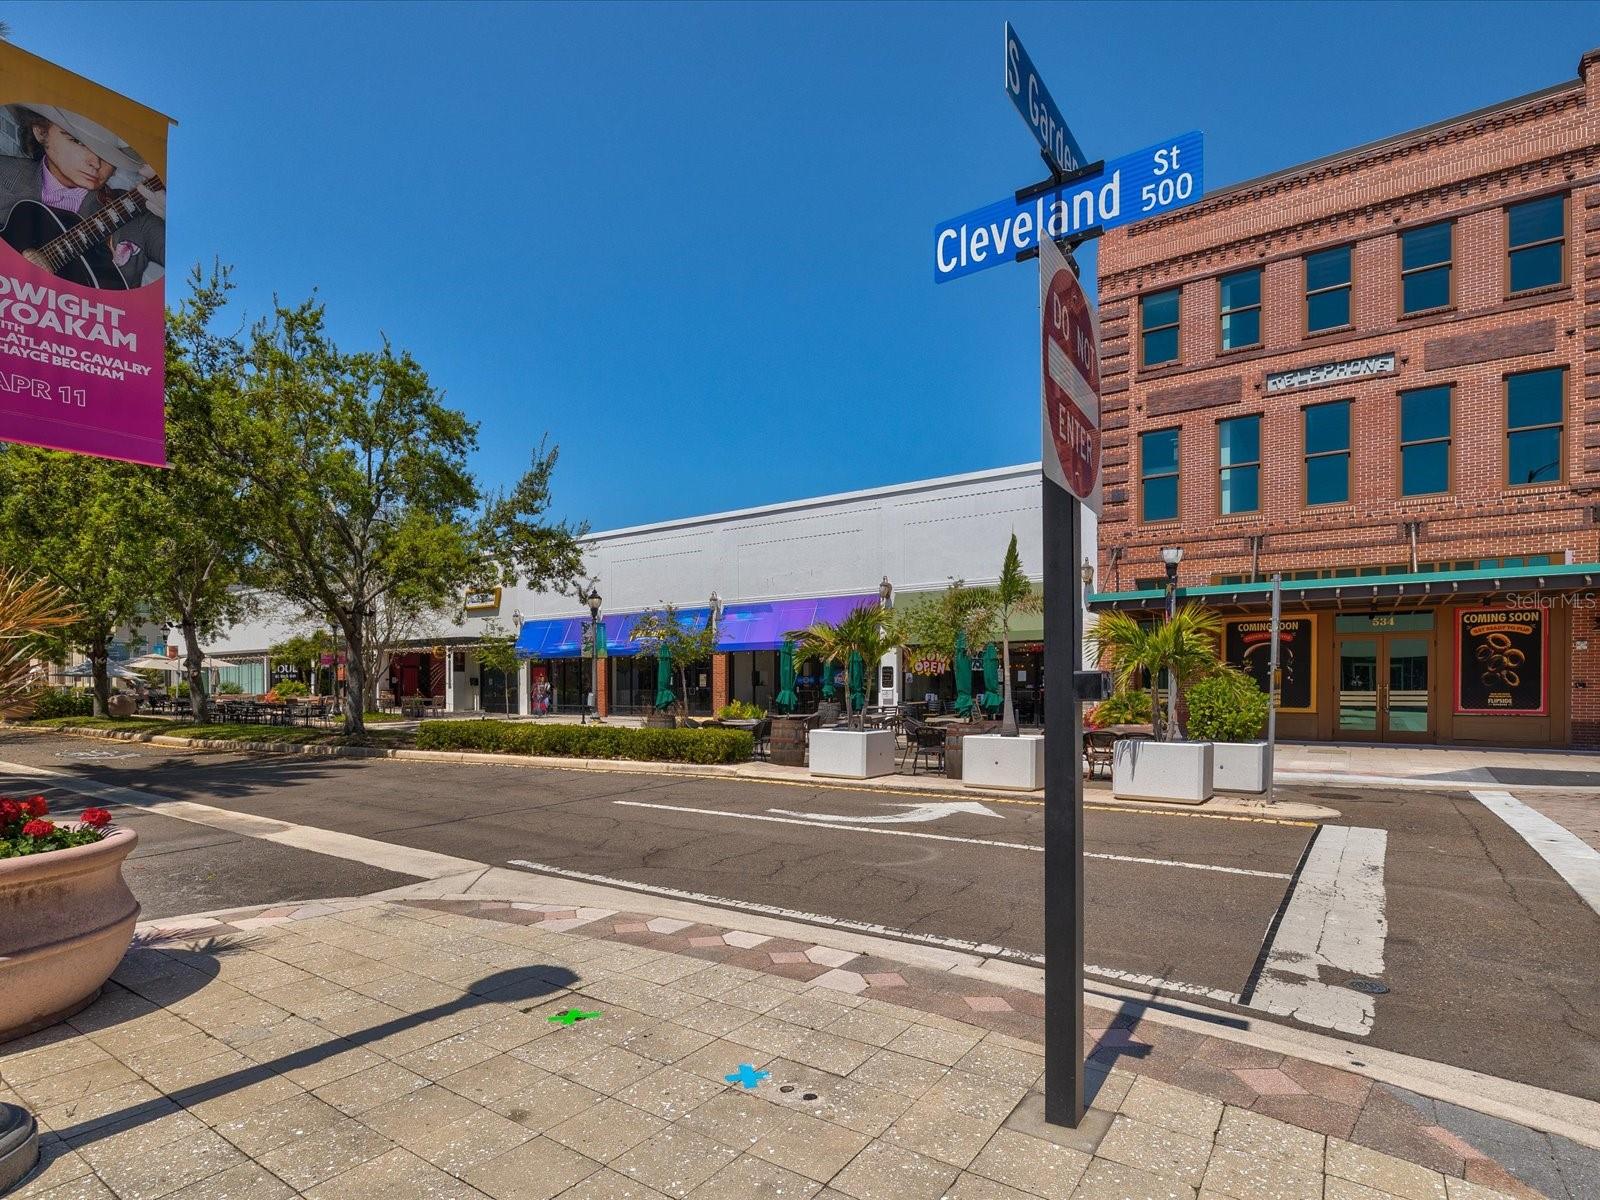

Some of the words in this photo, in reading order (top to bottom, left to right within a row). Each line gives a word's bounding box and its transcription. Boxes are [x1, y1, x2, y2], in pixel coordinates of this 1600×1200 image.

[1008, 39, 1020, 95] S
[1142, 172, 1193, 212] 500
[936, 168, 1121, 274] Cleveland
[1153, 145, 1181, 175] St
[0, 320, 24, 334] ITH
[1053, 291, 1069, 341] DO
[1076, 325, 1095, 377] NOT
[0, 343, 49, 363] HAYCE
[52, 355, 124, 381] BECKHAM
[81, 350, 152, 376] CAVALRY
[1268, 357, 1395, 391] TELEPHONE
[59, 386, 86, 407] 11
[1058, 402, 1093, 467] ENTER
[1238, 622, 1272, 632] COMING
[1275, 621, 1299, 630] OON
[1463, 613, 1507, 623] COMING
[1508, 611, 1539, 622] SOON
[271, 664, 298, 674] OUL
[914, 660, 945, 675] OPEN
